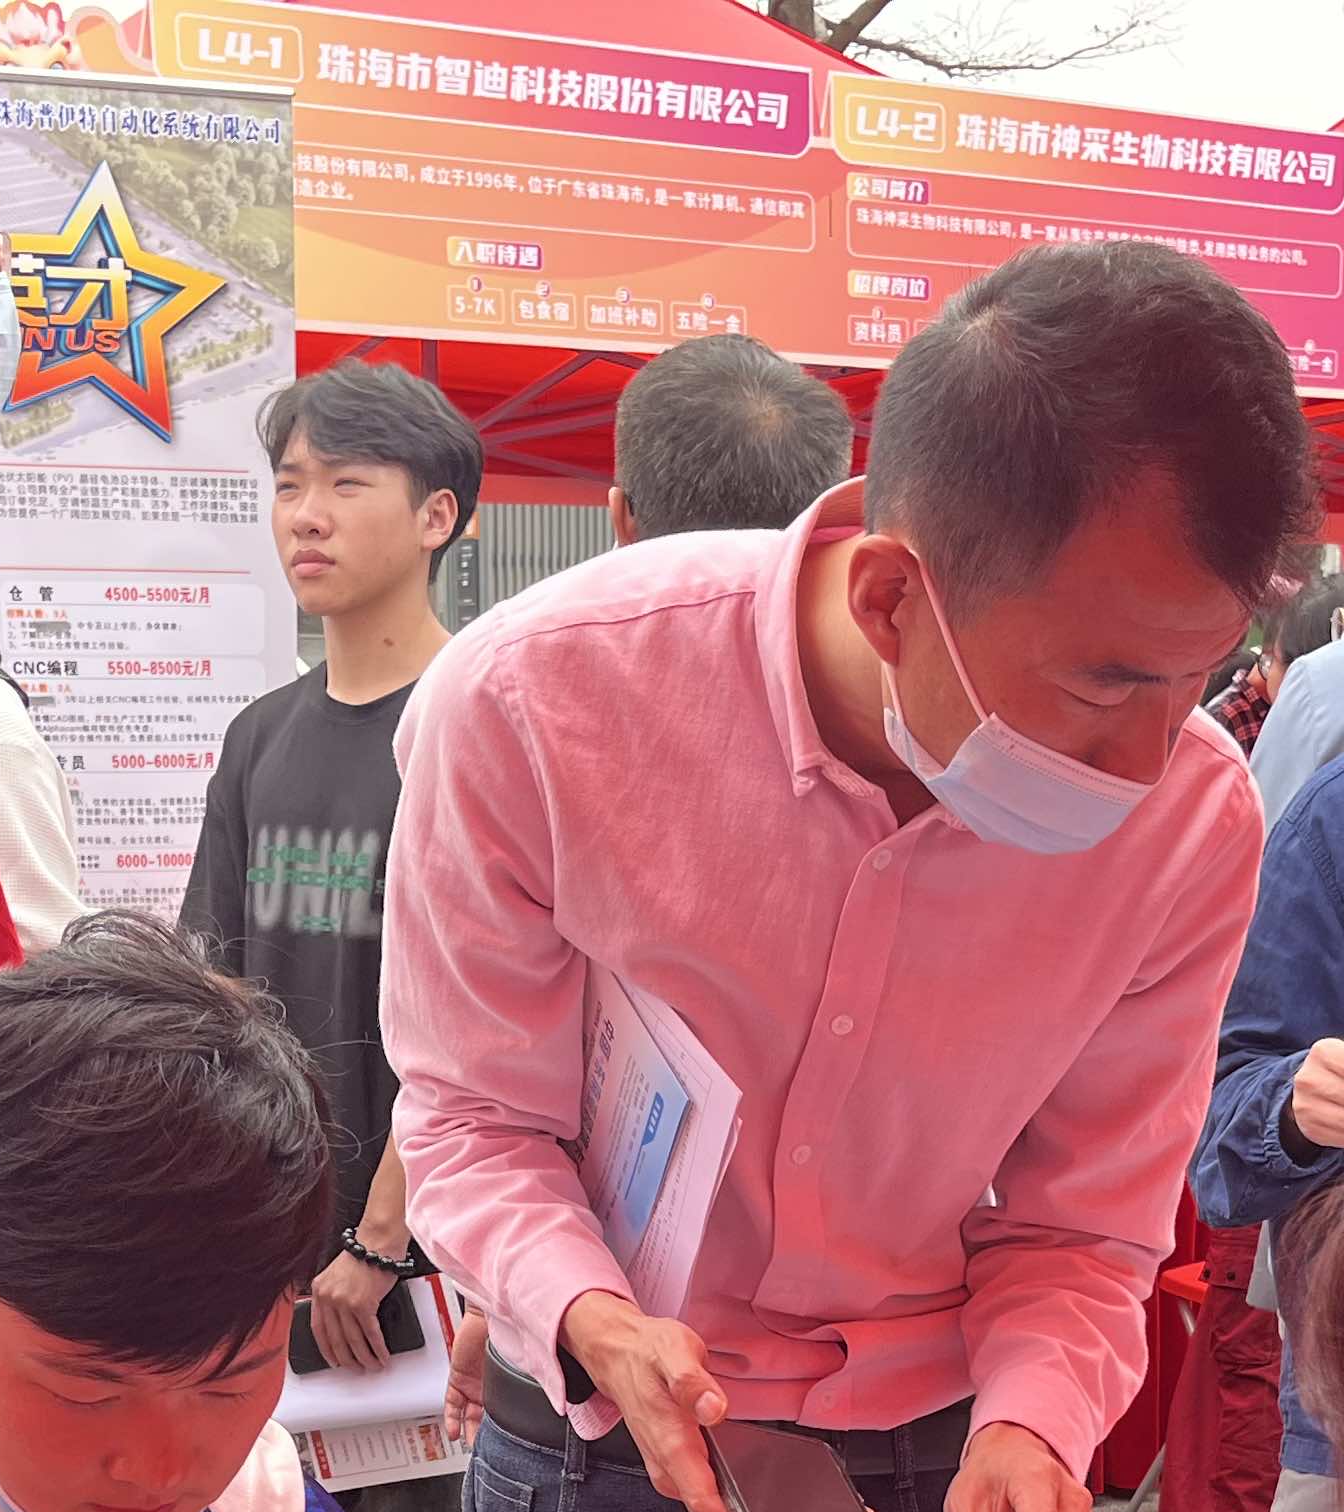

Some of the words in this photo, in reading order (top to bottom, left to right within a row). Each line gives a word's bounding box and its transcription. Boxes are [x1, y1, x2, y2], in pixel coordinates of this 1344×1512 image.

[197, 27, 283, 71] L4-1
[316, 43, 789, 130] 珠海市智迪科技股份有限公司
[856, 105, 936, 143] L4-2
[956, 112, 1334, 187] 珠海市神采生物科技有限公司
[854, 177, 924, 202] 公司简介
[456, 241, 538, 266] 入职待遇
[456, 297, 496, 315] 5-7K
[519, 301, 569, 321] 包食宿
[591, 305, 656, 327] 加班补助
[677, 312, 741, 334] 五险一金
[20, 327, 54, 349] N
[64, 327, 120, 352] US
[855, 322, 901, 343] 资料员
[13, 660, 79, 676] CNC编程
